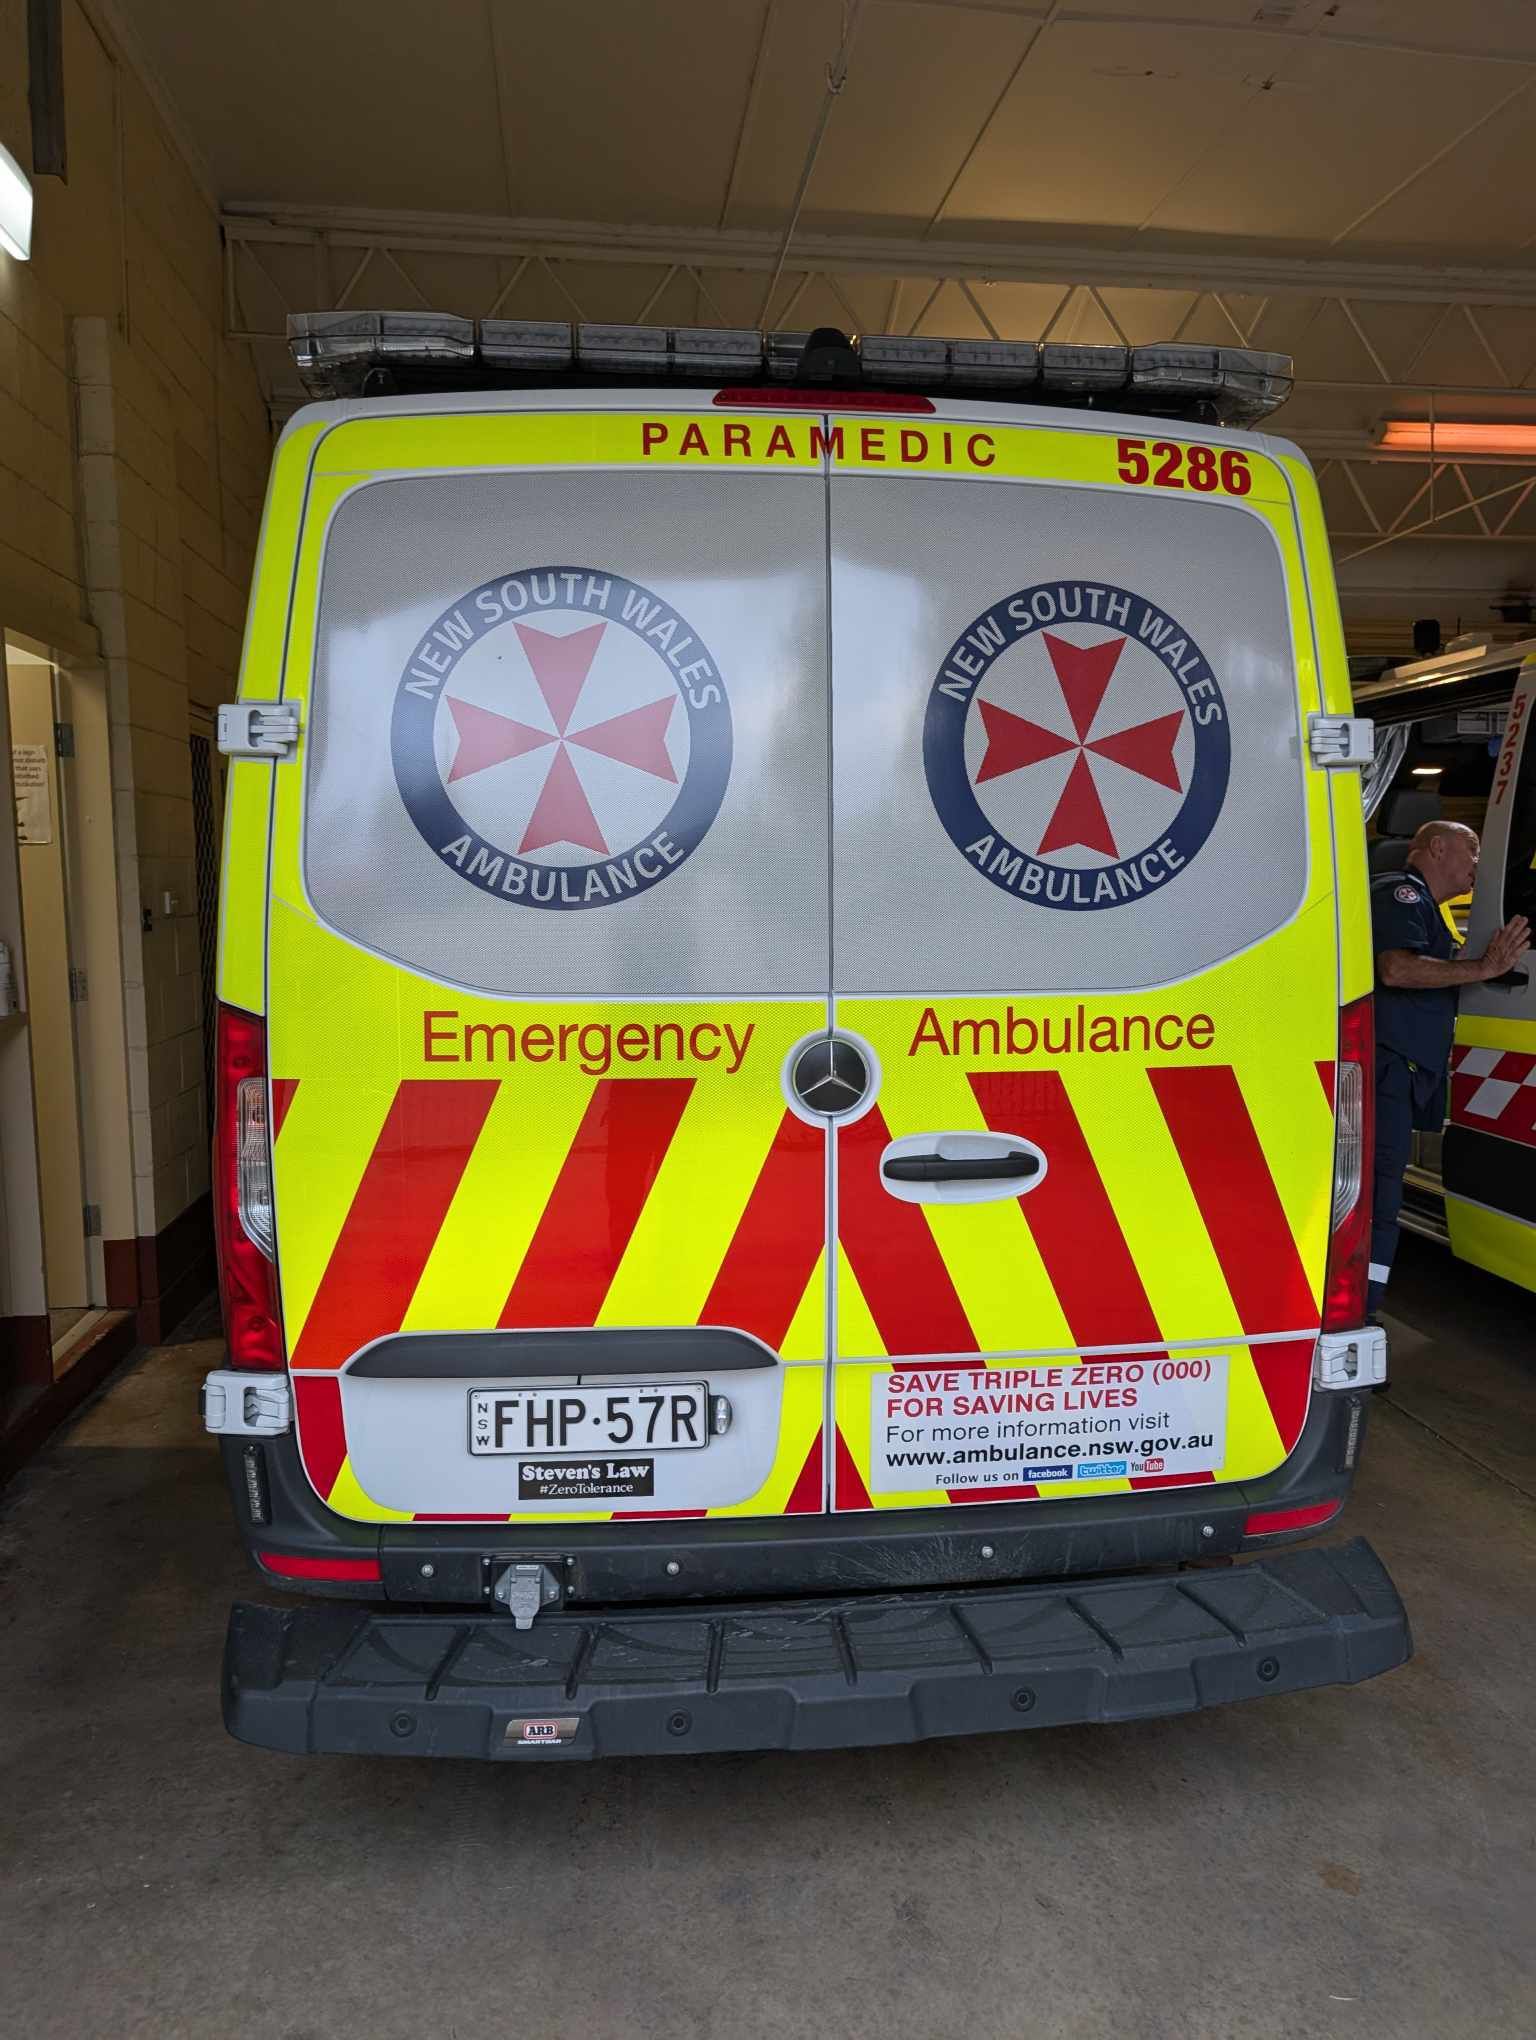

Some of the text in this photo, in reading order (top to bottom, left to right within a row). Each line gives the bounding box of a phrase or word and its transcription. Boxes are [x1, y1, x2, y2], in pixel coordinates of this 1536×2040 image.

[641, 422, 996, 467] PARAMEDIC
[1117, 438, 1252, 496] 5286
[405, 573, 722, 710] NEW SOUTH WALES
[938, 587, 1223, 727] NEW SOUTH WALES
[1495, 693, 1527, 805] 5237
[440, 831, 685, 904] AMBULANCE
[966, 837, 1186, 904] AMBULANCE
[422, 1010, 755, 1076] Emergency
[909, 1005, 1216, 1057] Ambulance
[888, 1360, 1212, 1394] SAVE TRIPLE ZERO (000)
[887, 1388, 1138, 1418] FOR SAVING LIVES
[886, 1411, 1171, 1443] For more information visit
[886, 1432, 1214, 1467] www.ambulance.nsw.gov.au
[522, 1462, 650, 1482] Steven's Law
[539, 1483, 634, 1496] #ZeroTolerance
[936, 1473, 978, 1485] Follow
[983, 1473, 998, 1482] us
[1003, 1472, 1019, 1481] on
[1028, 1468, 1068, 1479] facebook
[1079, 1462, 1125, 1476] twitter
[528, 1726, 554, 1736] ARB
